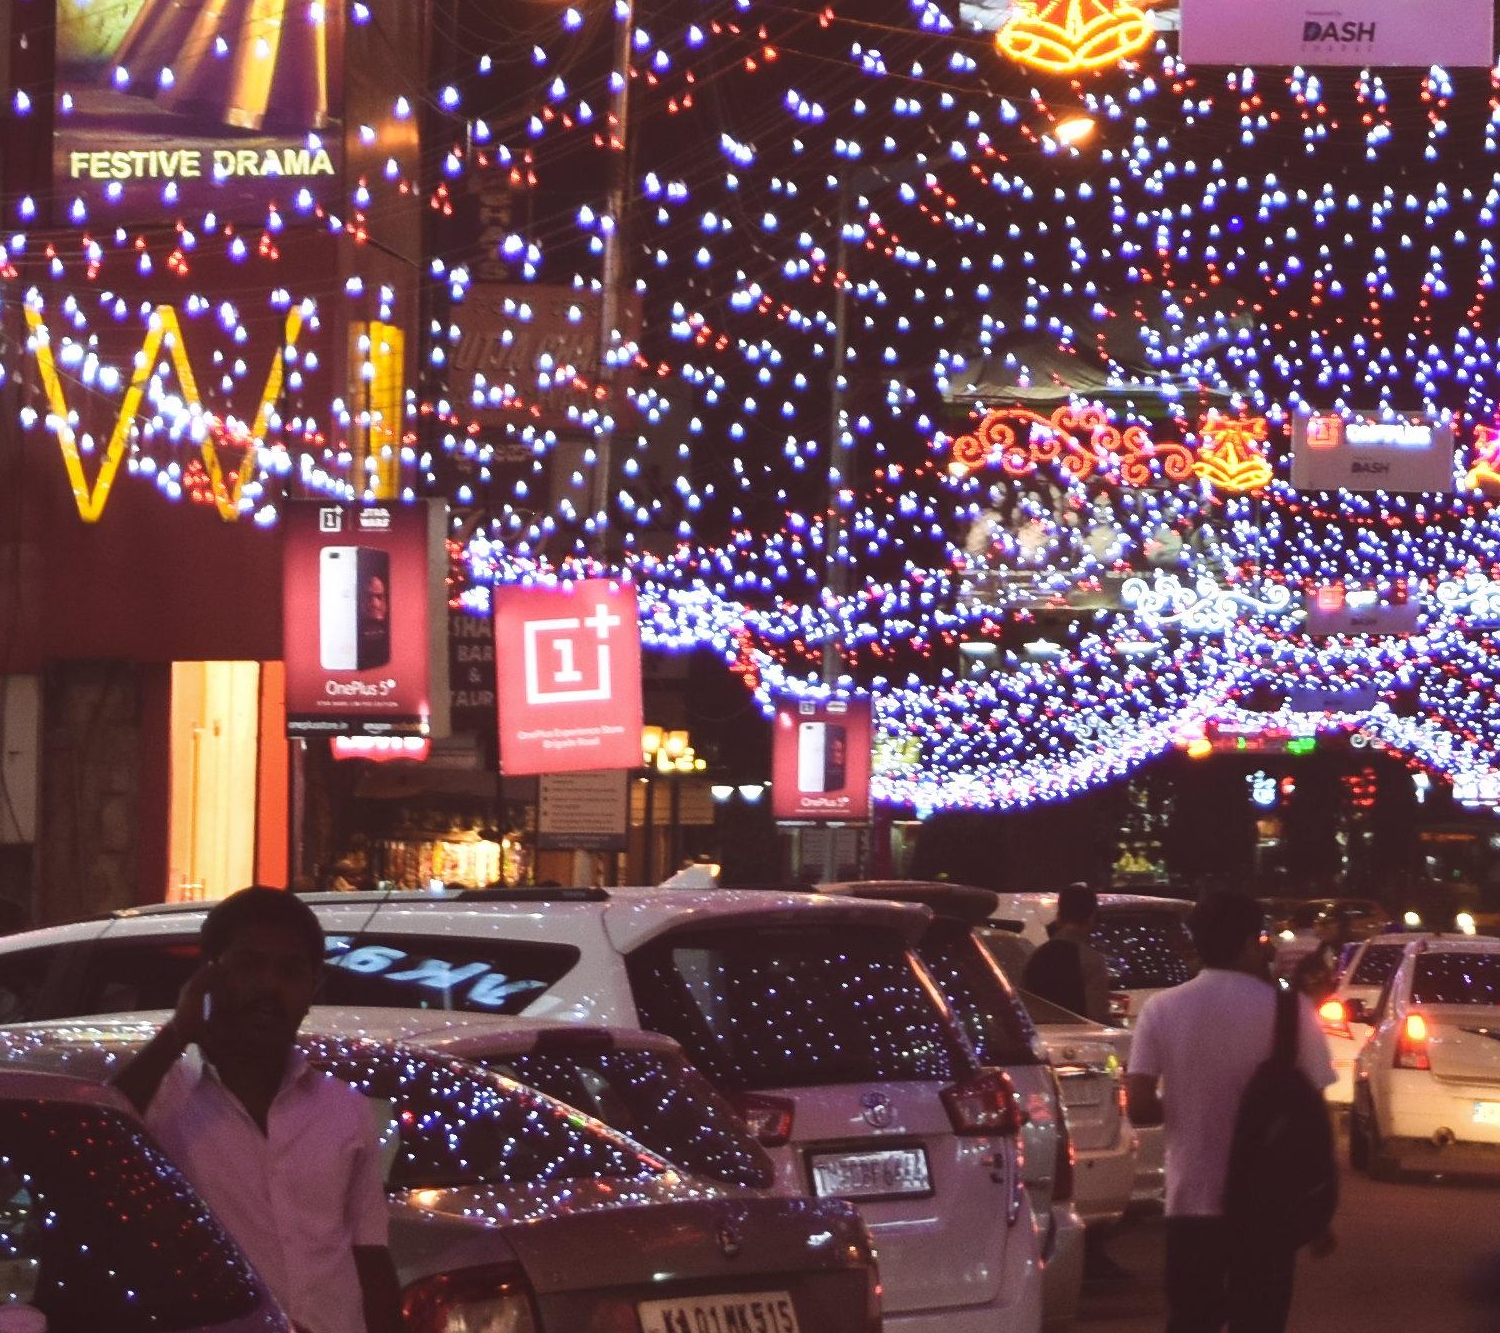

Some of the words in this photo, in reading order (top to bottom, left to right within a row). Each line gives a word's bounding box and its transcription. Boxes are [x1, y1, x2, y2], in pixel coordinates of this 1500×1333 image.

[1303, 21, 1376, 42] DASH
[71, 151, 201, 179] FESTIVE
[214, 149, 335, 177] DRAMA
